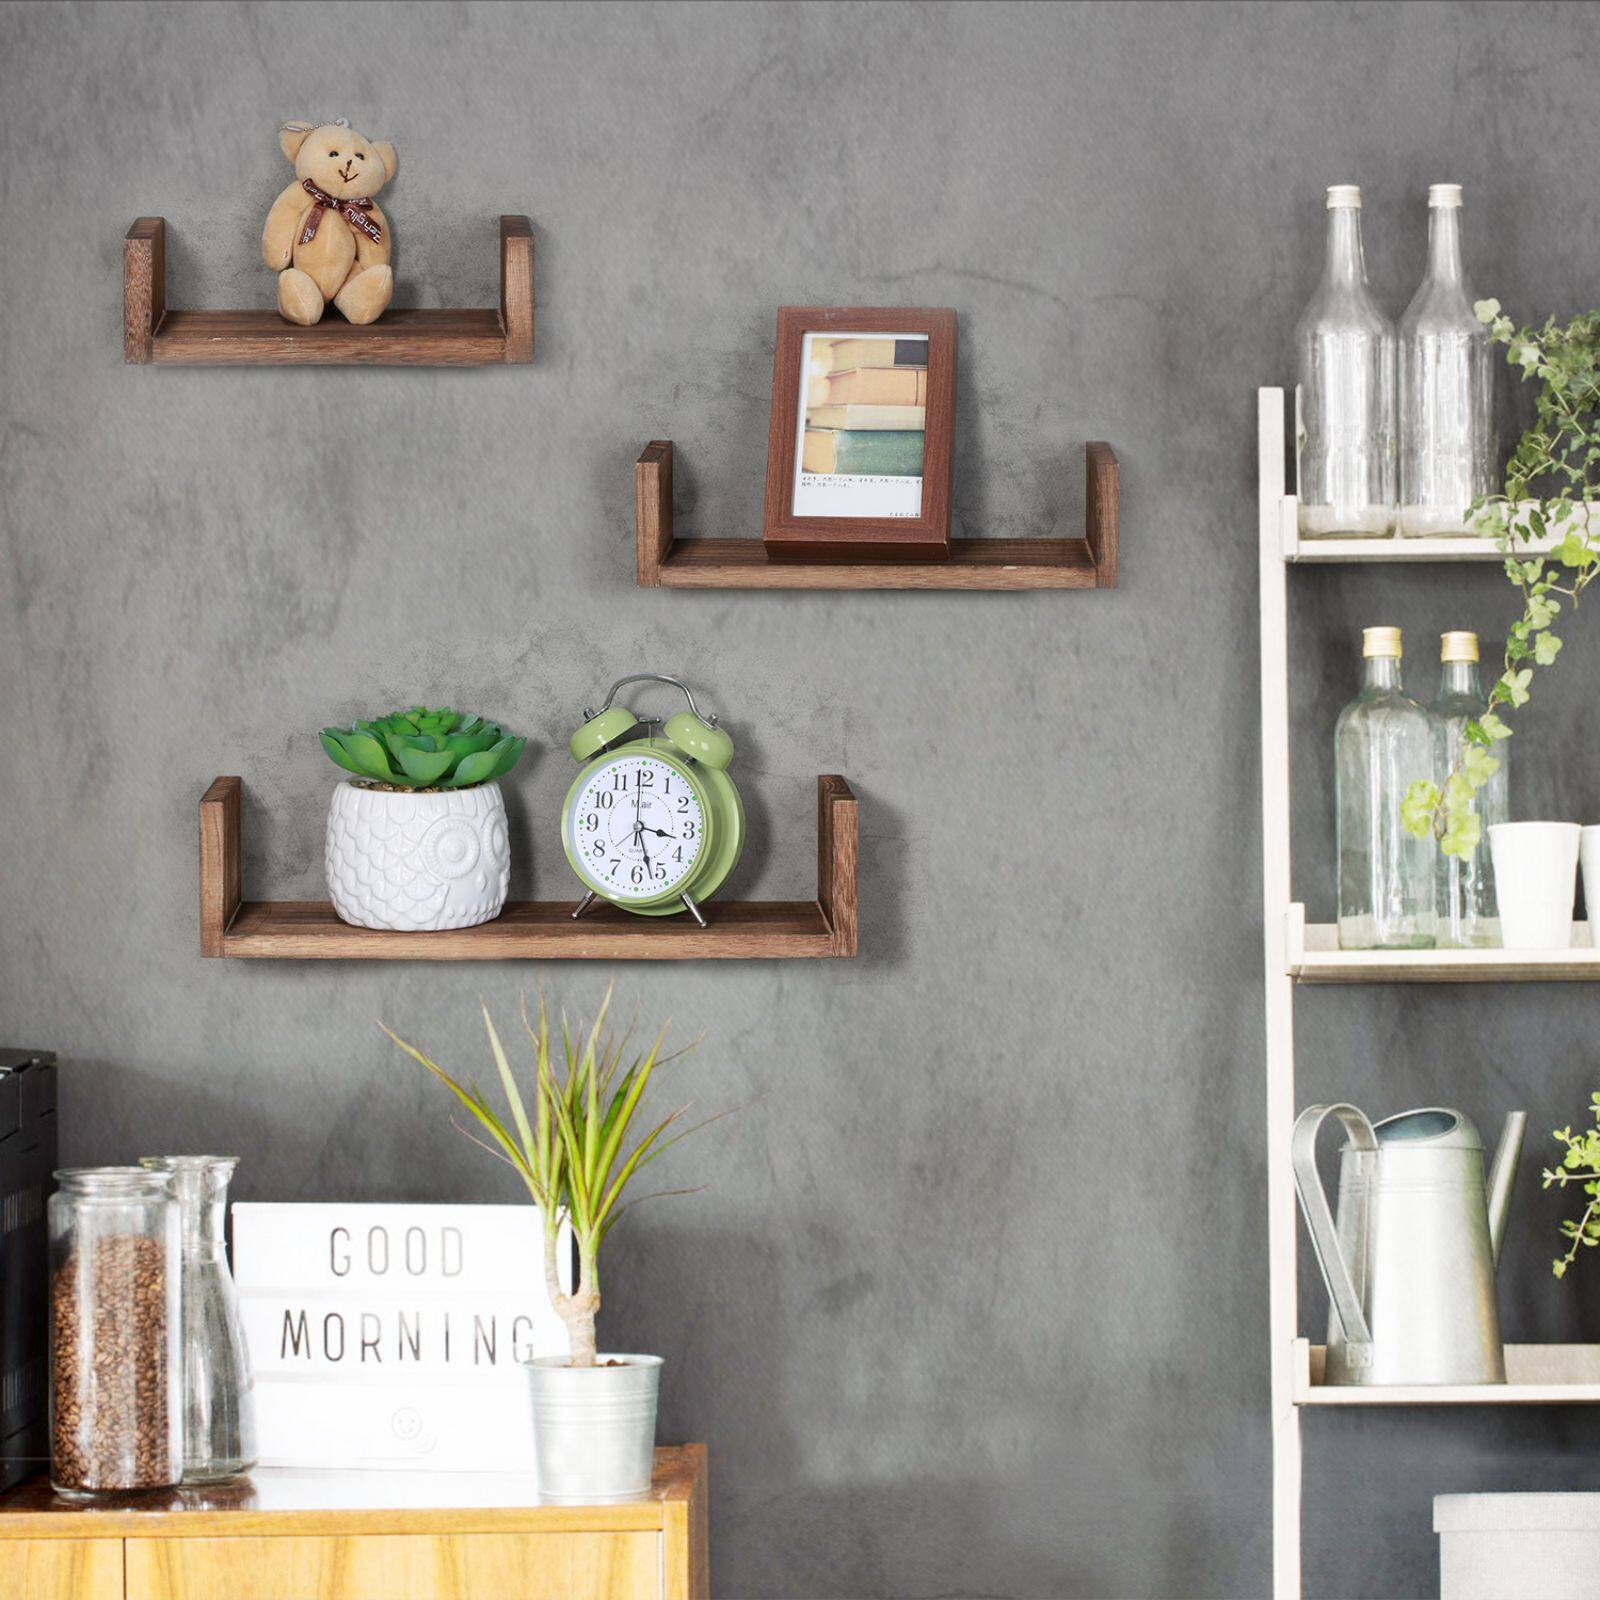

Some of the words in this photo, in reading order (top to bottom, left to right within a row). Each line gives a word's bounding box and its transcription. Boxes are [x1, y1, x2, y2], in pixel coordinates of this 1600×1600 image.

[613, 774, 628, 791] 11
[635, 769, 654, 787] 12
[664, 777, 671, 794] 1
[595, 791, 613, 809] 10
[677, 797, 689, 813] 2
[586, 813, 599, 832] 9
[683, 821, 695, 840] 3
[592, 839, 606, 858] 8
[671, 845, 684, 863] 4
[610, 859, 621, 876] 7
[631, 865, 643, 884] 6
[655, 862, 667, 880] 5
[330, 1225, 463, 1277] GOOD
[280, 1309, 534, 1365] MORNING
